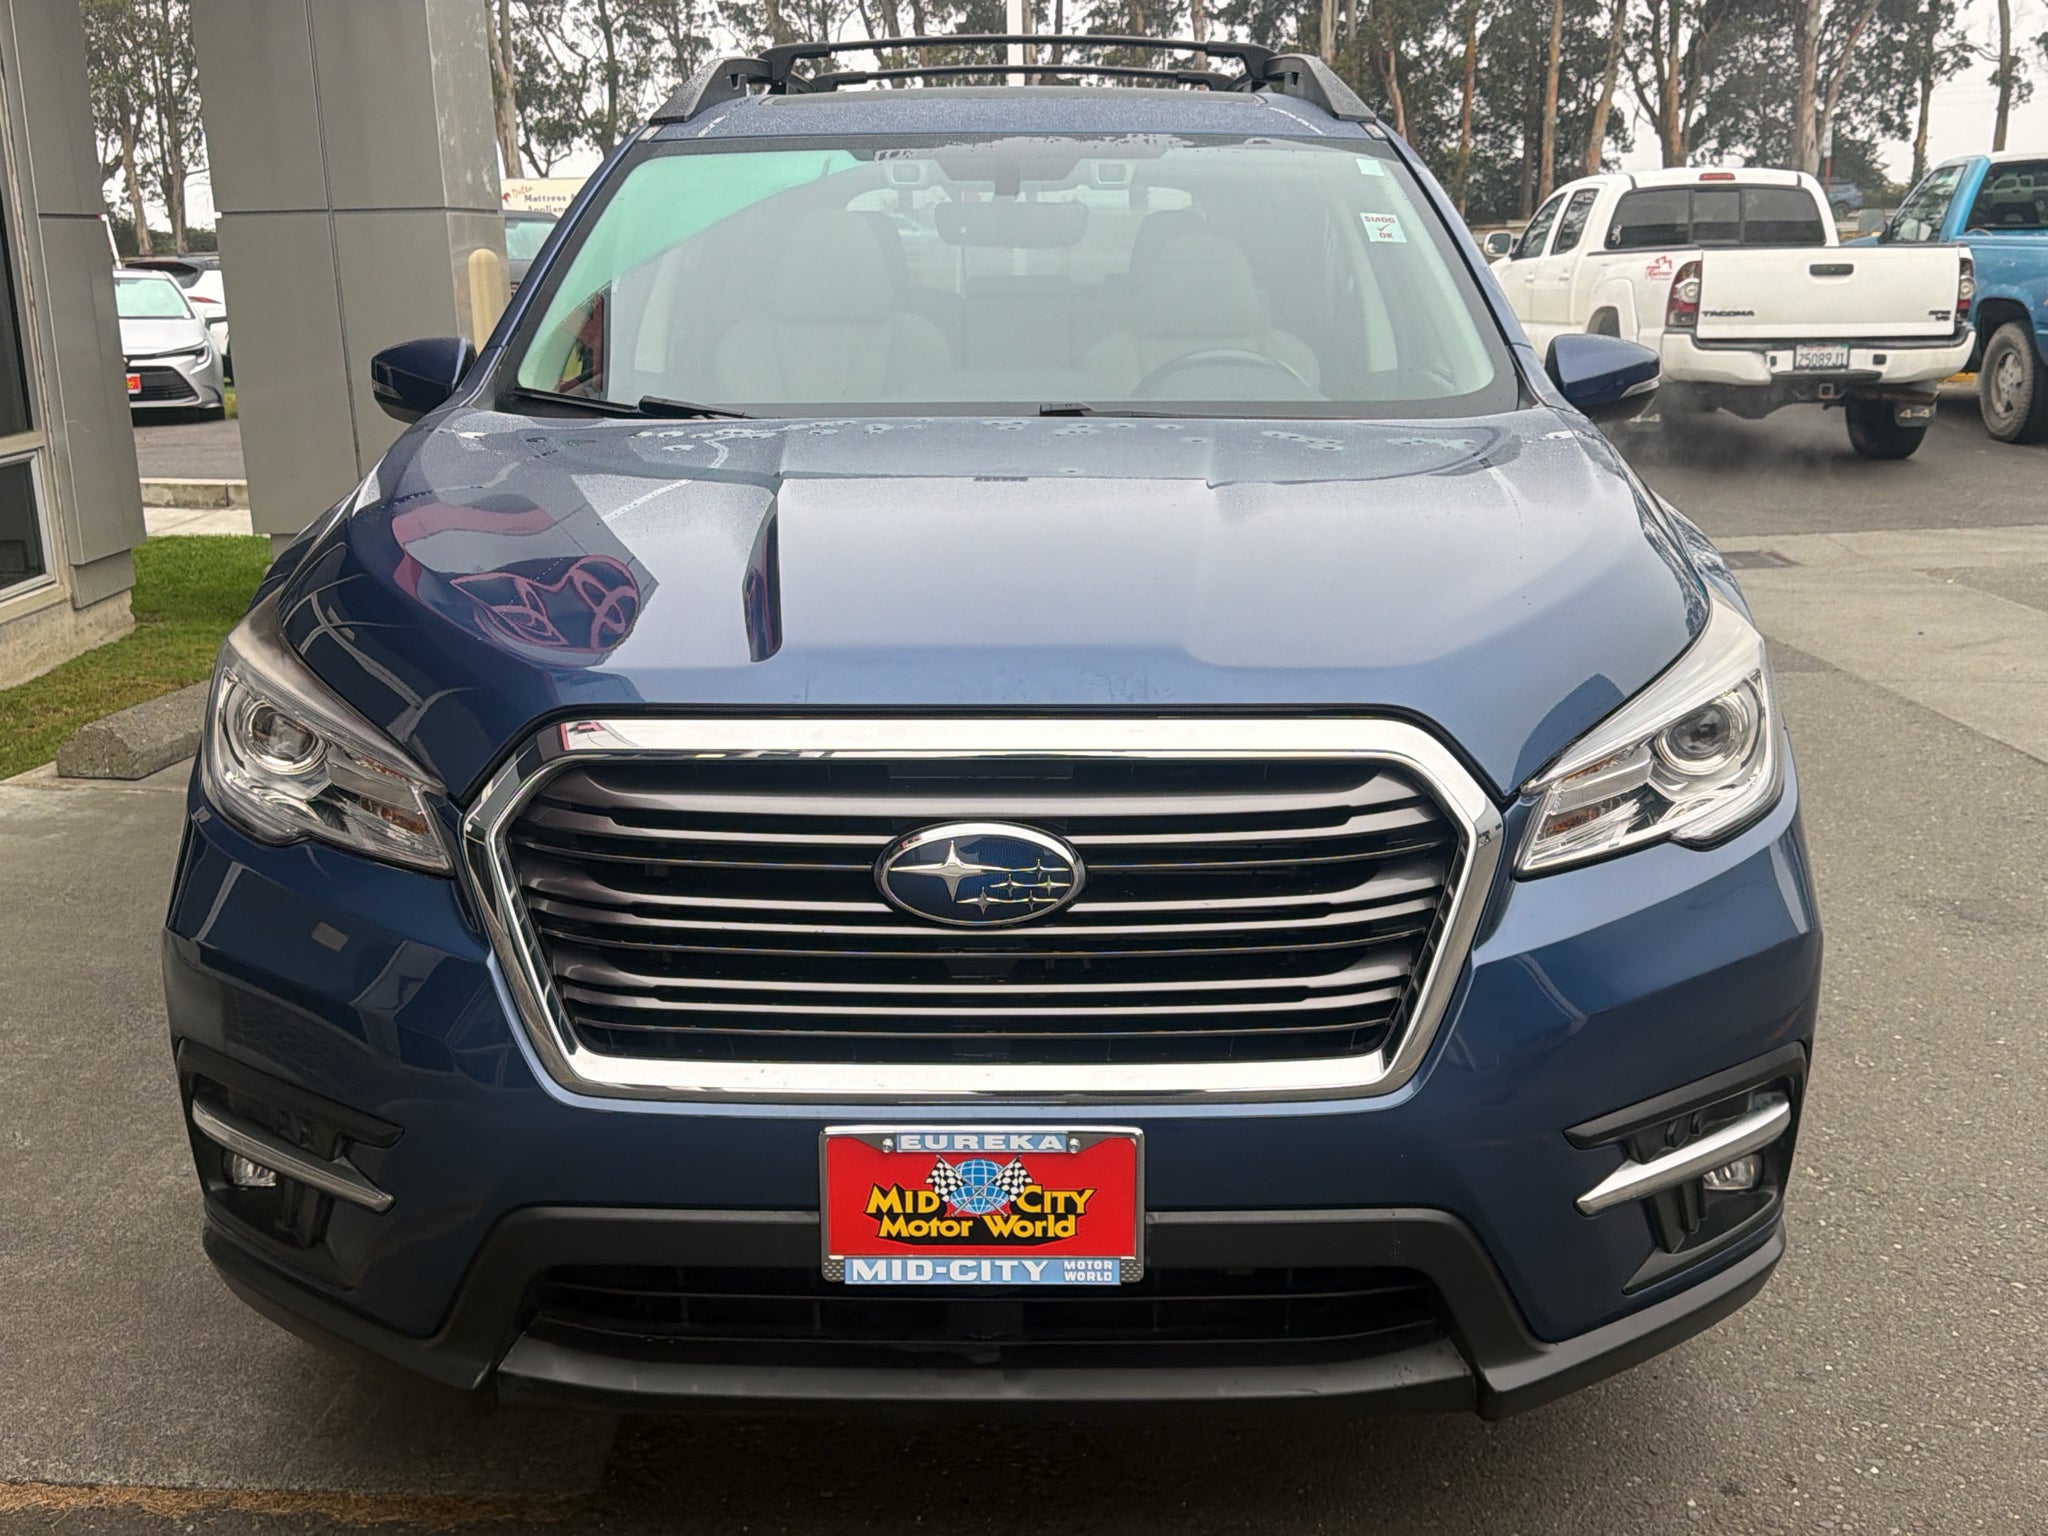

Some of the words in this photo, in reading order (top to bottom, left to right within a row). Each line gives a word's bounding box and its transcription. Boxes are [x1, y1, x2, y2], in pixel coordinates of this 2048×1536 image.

[524, 194, 567, 202] Mattress
[528, 205, 567, 213] Applian
[900, 1134, 1064, 1150] EUREKA
[865, 1184, 941, 1214] MID
[1016, 1184, 1096, 1214] CITY
[878, 1213, 974, 1238] Motor
[981, 1213, 1076, 1238] World
[852, 1259, 1049, 1282] MID-CITY
[1063, 1260, 1113, 1271] MOTOR
[1063, 1271, 1113, 1282] WORLD
